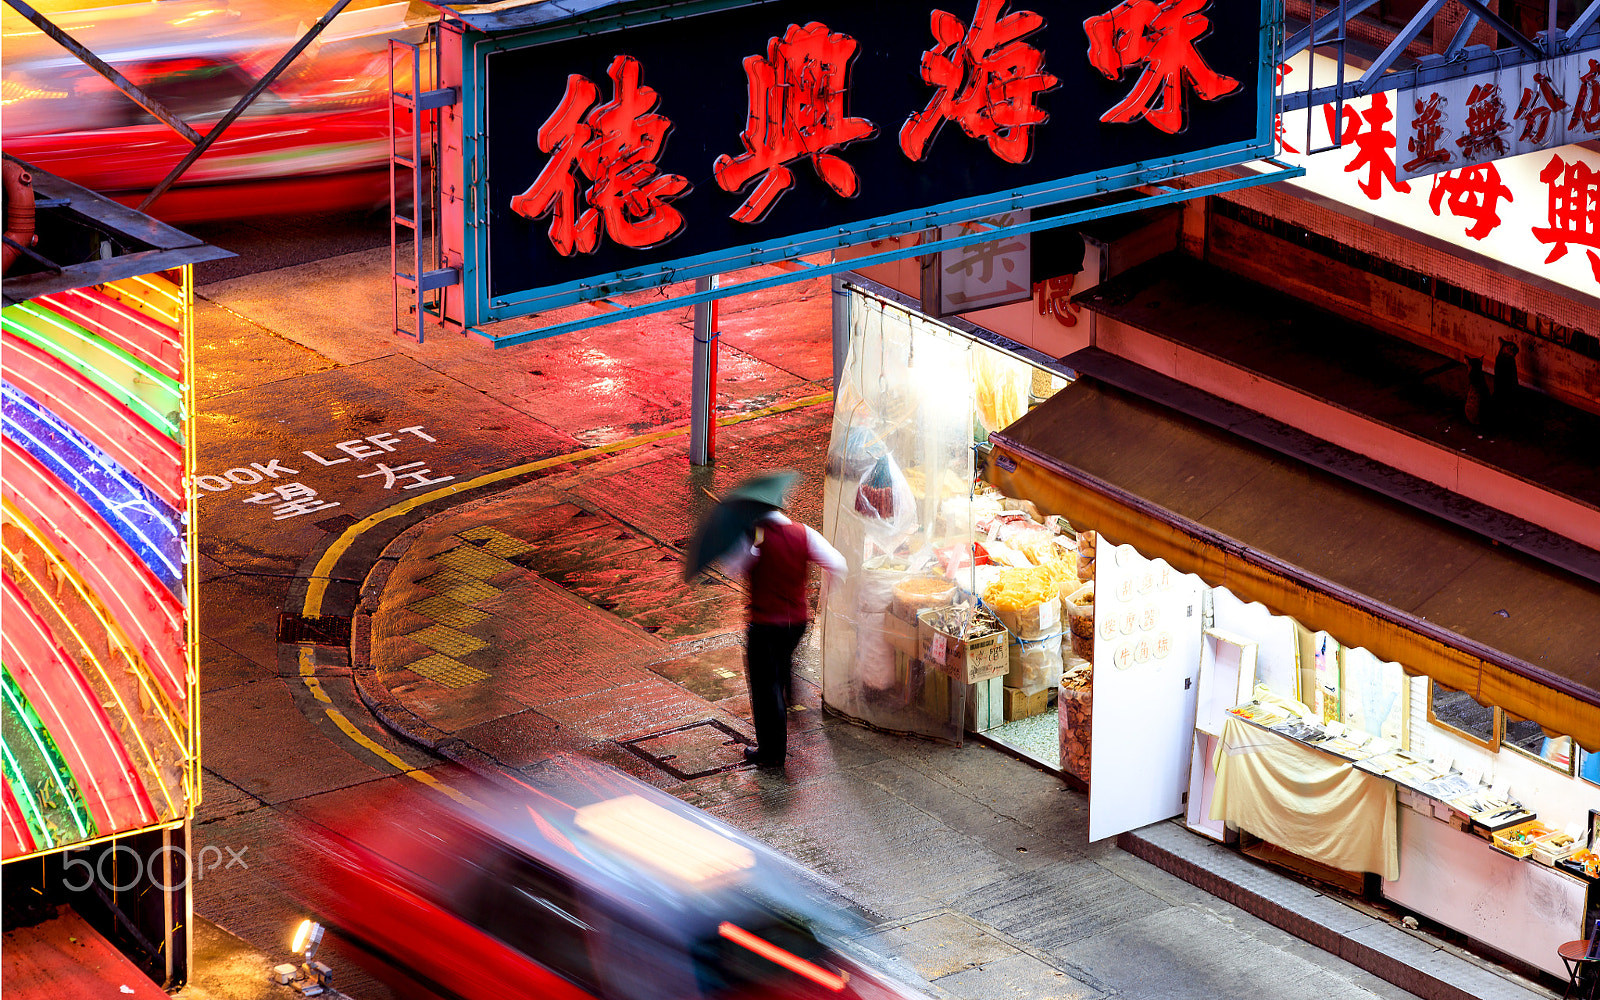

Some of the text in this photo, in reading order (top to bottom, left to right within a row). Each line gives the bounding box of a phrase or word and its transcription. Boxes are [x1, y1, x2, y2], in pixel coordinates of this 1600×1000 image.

[510, 0, 1244, 257] 德興海味
[302, 425, 437, 466] LEFT
